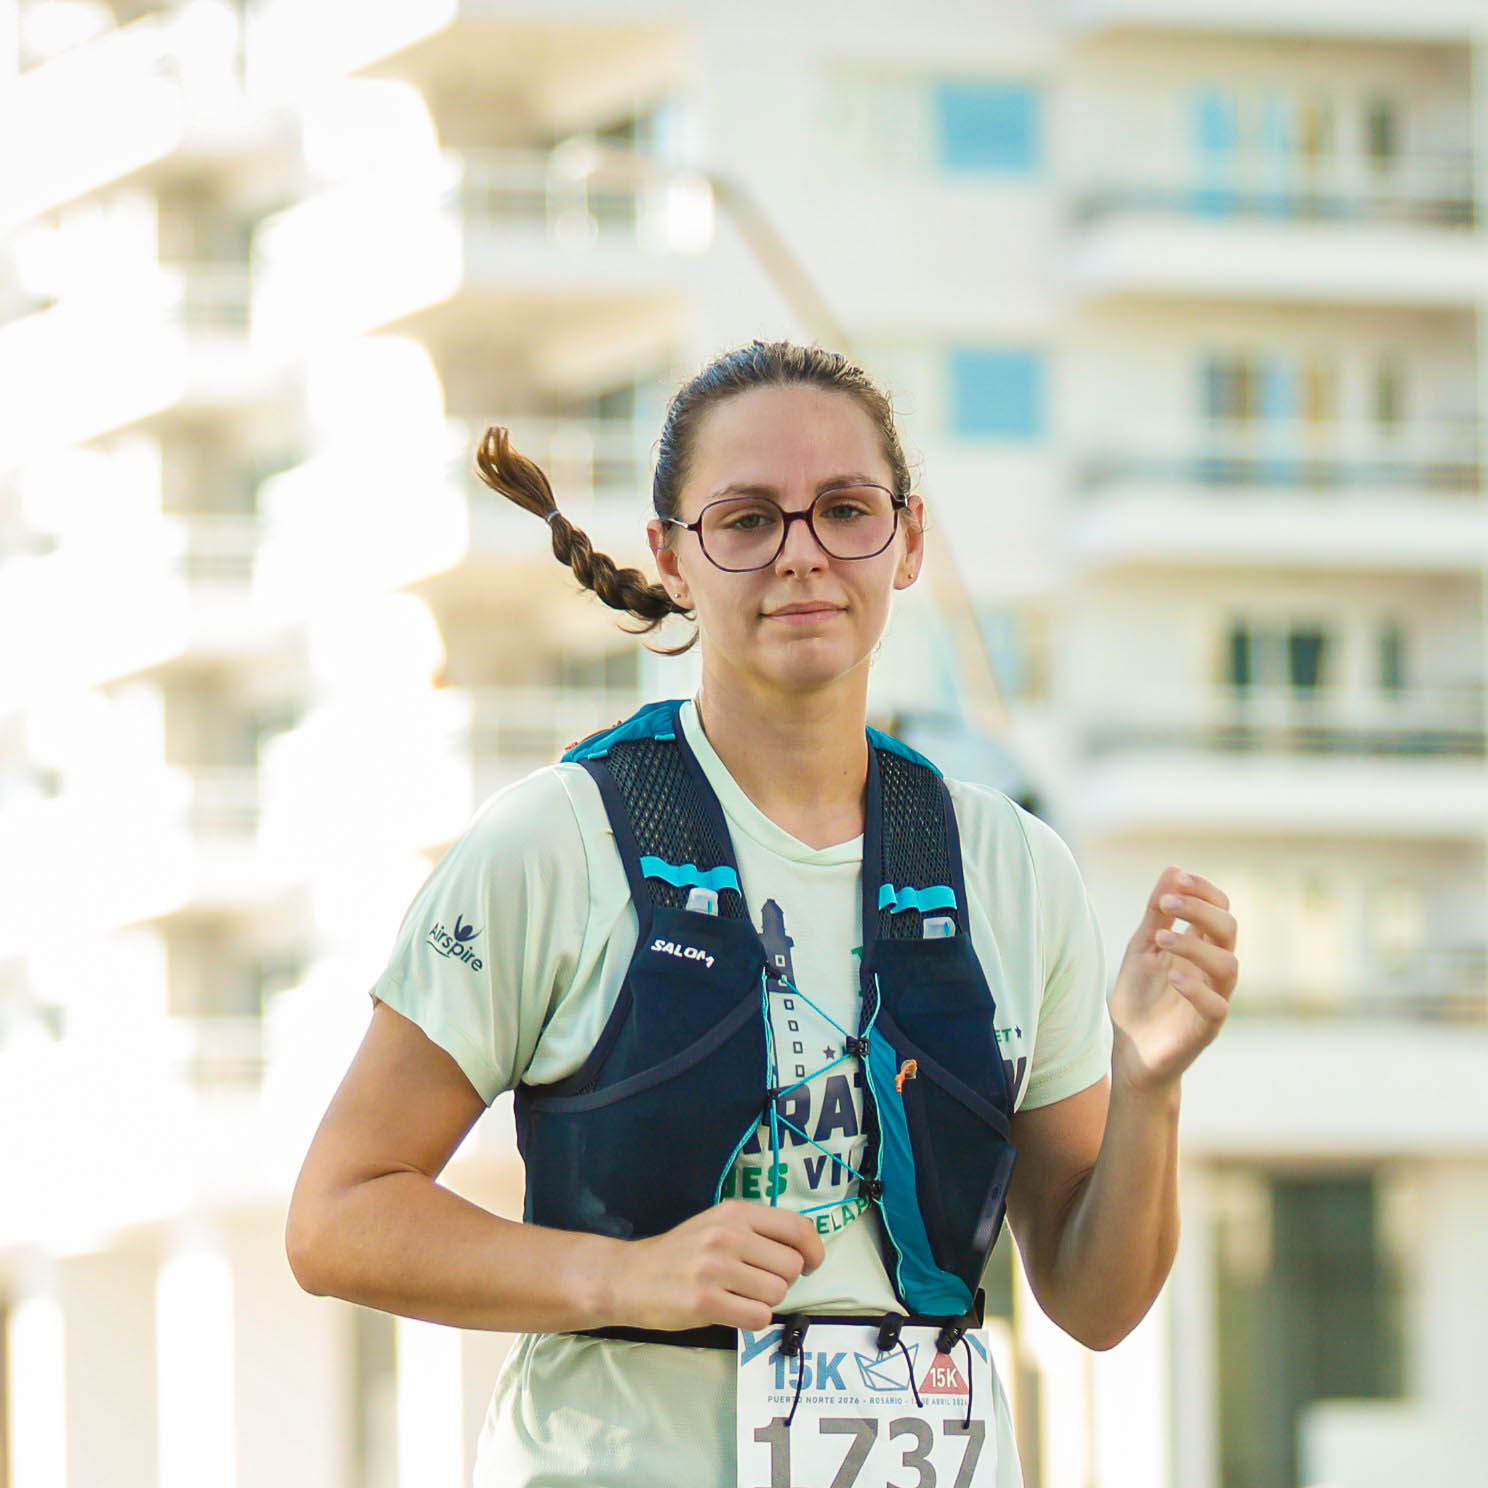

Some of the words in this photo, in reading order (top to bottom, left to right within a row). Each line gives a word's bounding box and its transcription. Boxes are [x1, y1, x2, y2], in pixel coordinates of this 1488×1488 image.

[428, 921, 483, 972] Airspire
[768, 1351, 847, 1390] 15K
[929, 1367, 959, 1388] 15K
[805, 1396, 835, 1405] NORTE
